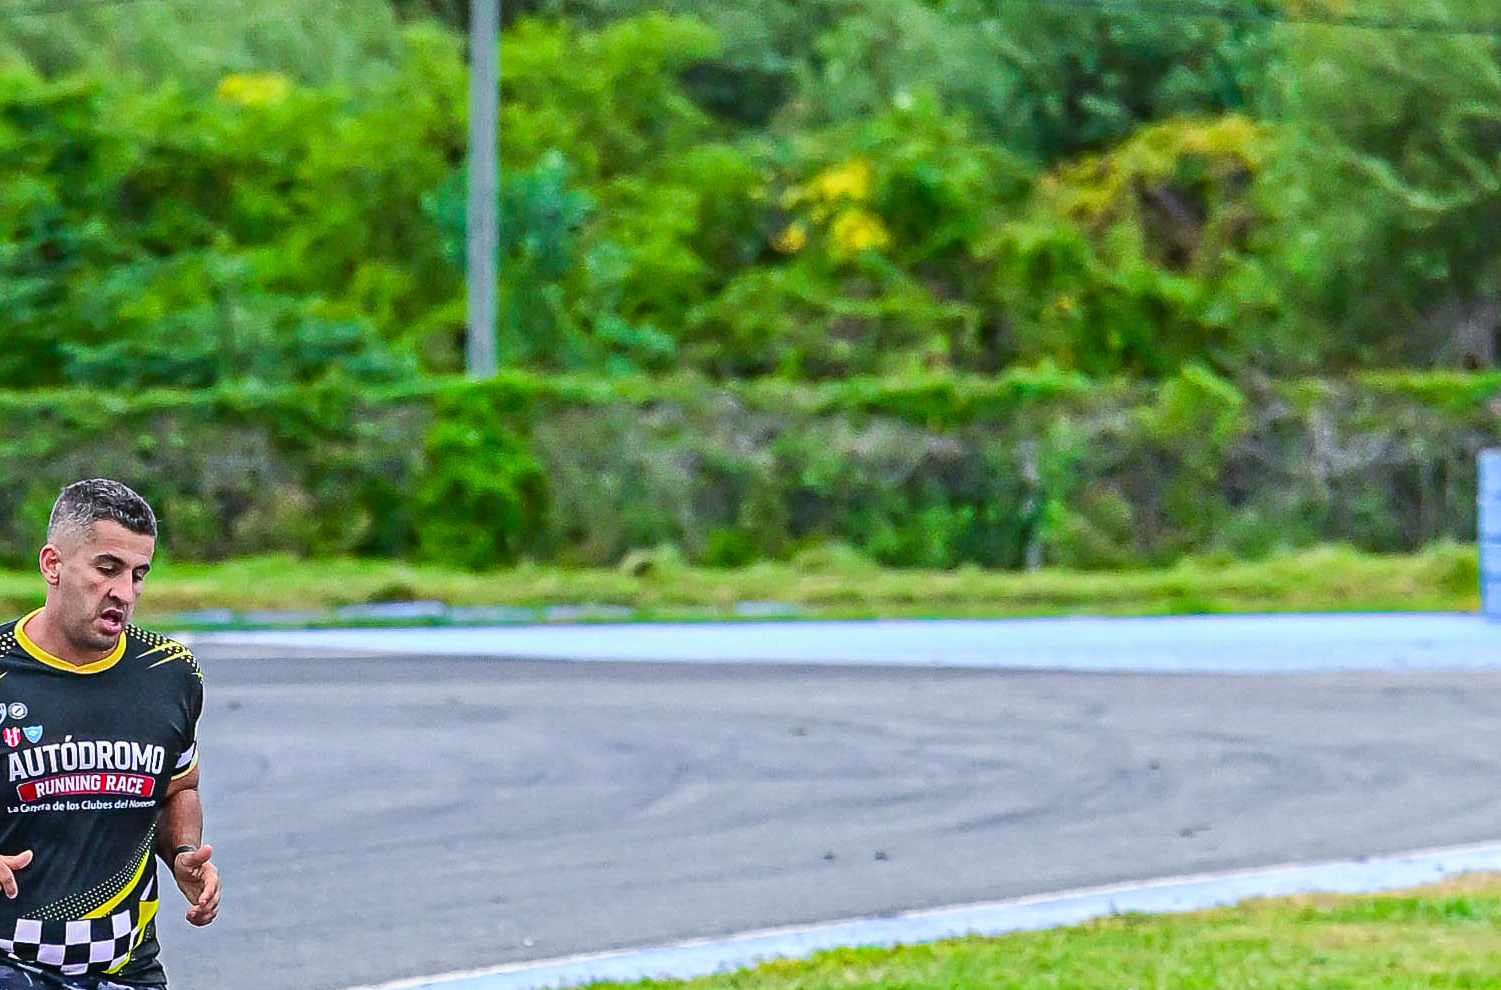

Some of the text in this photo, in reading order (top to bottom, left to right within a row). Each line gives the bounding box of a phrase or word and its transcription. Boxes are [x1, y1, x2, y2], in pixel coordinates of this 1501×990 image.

[8, 735, 165, 782] AUTÓDROMO
[36, 774, 144, 798] RUNNING RACE
[7, 806, 19, 814] La
[52, 800, 65, 811] de
[66, 800, 80, 811] los
[81, 800, 113, 810] Clubes
[114, 800, 128, 809] del
